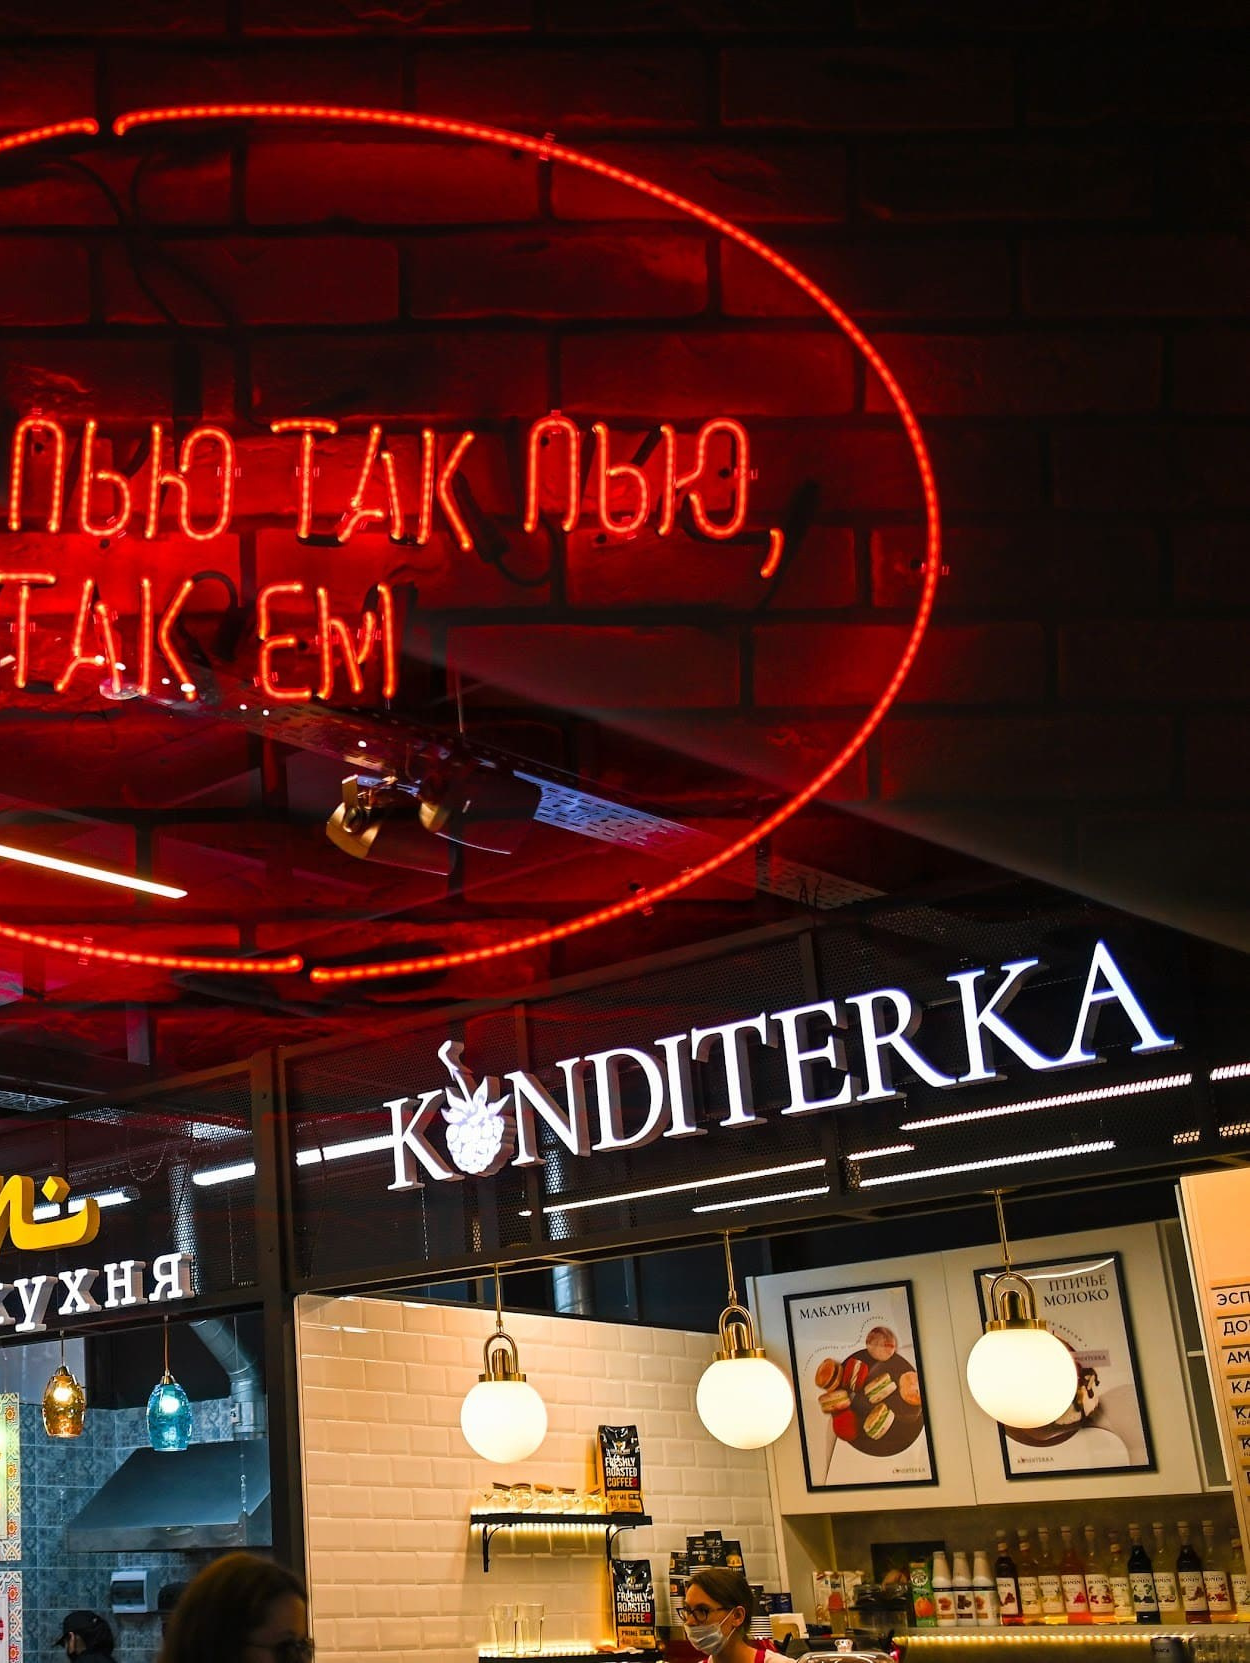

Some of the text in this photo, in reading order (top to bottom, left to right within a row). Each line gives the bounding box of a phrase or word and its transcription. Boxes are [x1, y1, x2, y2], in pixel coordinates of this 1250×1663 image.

[8, 416, 785, 578] ПЬЮ ТАК ПЬЮ,
[258, 582, 396, 702] ЕМ
[1049, 1273, 1108, 1293] ПТИЧЬЕ
[1043, 1288, 1110, 1308] МОЛОКО
[799, 1300, 871, 1321] МАКАРУНИ
[1223, 1319, 1250, 1337] ДО
[606, 1466, 638, 1477] ROASTED
[606, 1477, 633, 1488] COFFEE
[616, 1591, 648, 1603] FRESHLY
[617, 1602, 651, 1613] ROASTED
[617, 1613, 646, 1623] COFFEE
